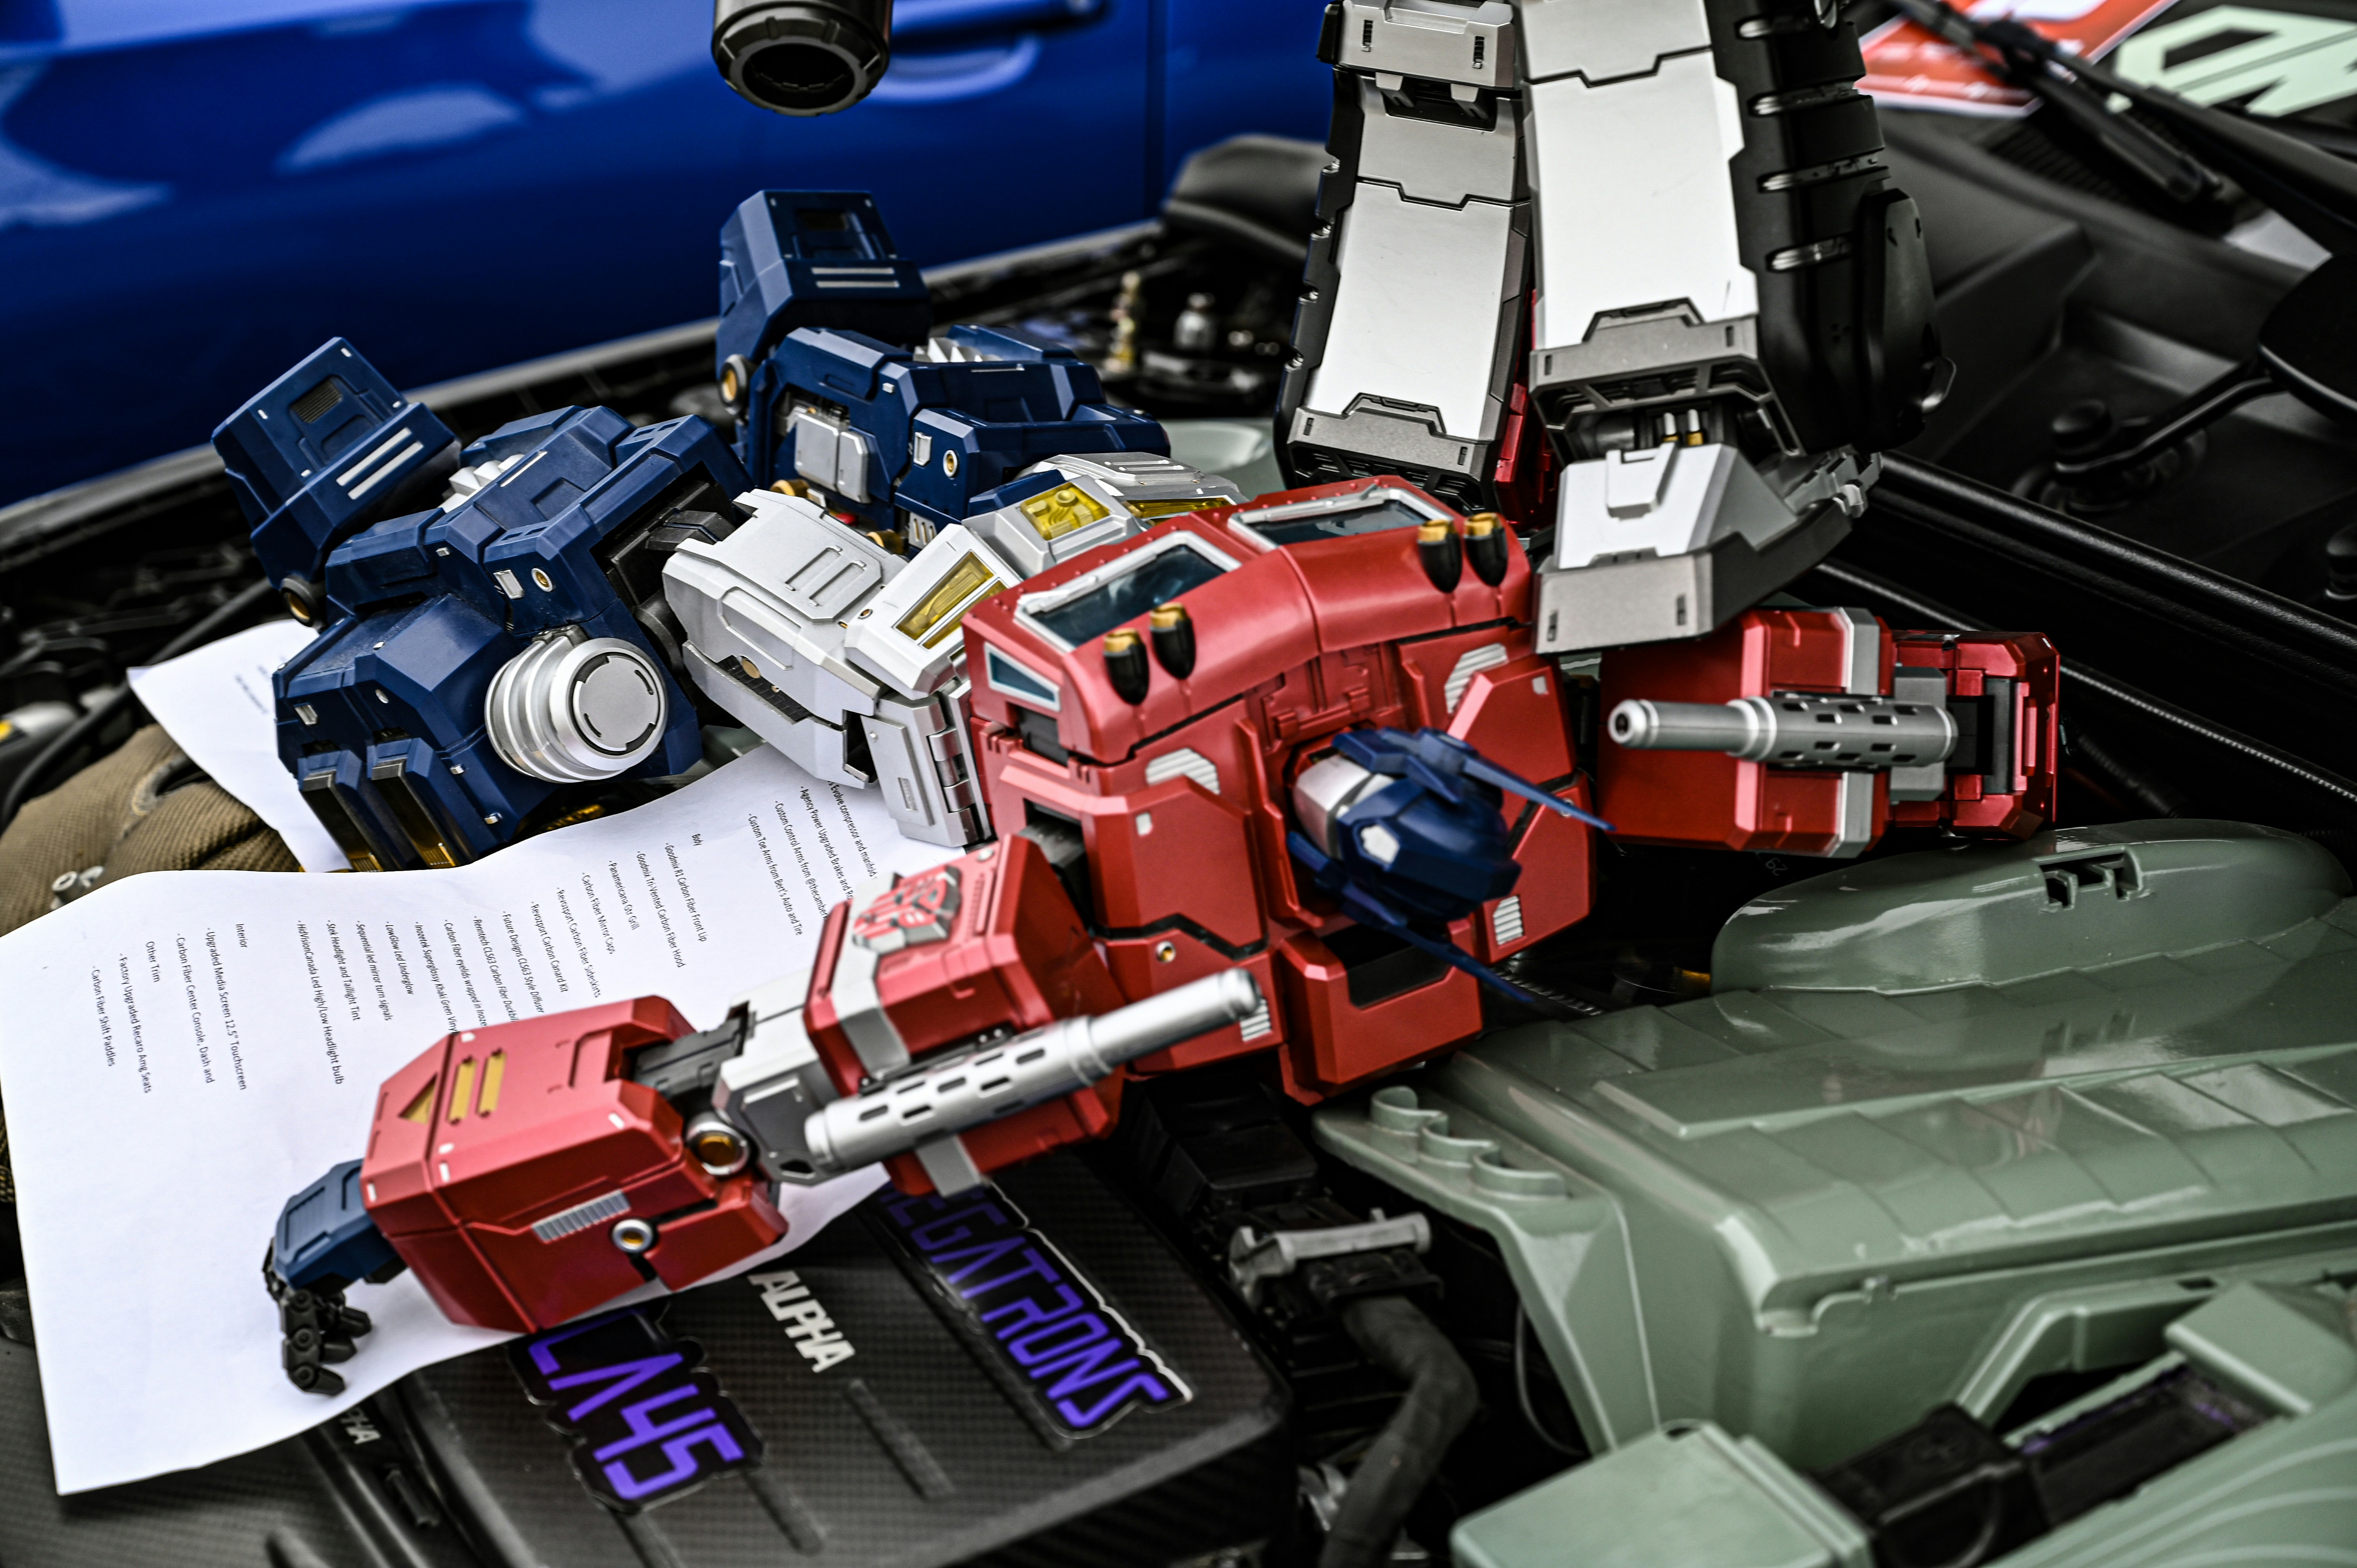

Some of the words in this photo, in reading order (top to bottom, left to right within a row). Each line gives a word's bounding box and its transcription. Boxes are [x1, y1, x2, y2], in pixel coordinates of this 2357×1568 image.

[830, 784, 845, 806] Evolve
[775, 803, 789, 825] Custom
[839, 805, 860, 839] compressor
[748, 816, 762, 838] Custom
[784, 825, 800, 847] Control
[691, 833, 704, 846] Body
[757, 837, 767, 849] Toe
[800, 789, 815, 811] Agency
[809, 809, 823, 829] Power
[818, 828, 838, 858] Upgraded
[830, 858, 845, 879] Brakes
[839, 879, 852, 891] and
[855, 839, 868, 852] and
[664, 845, 680, 869] Goodmix
[761, 849, 774, 865] Arms
[793, 847, 805, 863] Arms
[860, 851, 878, 877] manifold
[674, 869, 684, 878] R1
[768, 864, 779, 879] from
[800, 862, 811, 878] from
[608, 863, 628, 905] Panamericana
[677, 878, 691, 898] Carbon
[774, 879, 788, 897] Bert's
[624, 904, 633, 915] Gtr
[685, 898, 697, 913] Fiber
[781, 897, 793, 912] Auto
[805, 878, 829, 920] @thecamberk
[530, 904, 548, 937] Revozport
[581, 875, 595, 899] Carbon
[590, 898, 602, 915] Fiber
[597, 915, 610, 937] Mirror
[605, 937, 615, 954] Caps
[636, 853, 652, 878] Goodmix
[645, 877, 665, 909] Tri-Vented
[657, 909, 671, 932] Carbon
[666, 932, 677, 948] Fiber
[672, 949, 686, 968] Hood
[788, 913, 800, 924] and
[326, 923, 339, 936] Stek
[443, 923, 457, 943] Carbon
[473, 919, 491, 946] Renntech
[502, 914, 515, 934] Future
[628, 916, 640, 930] Grill
[691, 914, 704, 932] Front
[793, 923, 803, 936] Tire
[235, 923, 248, 948] Interior
[356, 924, 375, 953] Sequential
[385, 925, 400, 950] LowGlow
[414, 925, 431, 948] Inozetek
[509, 934, 523, 957] Designs
[557, 890, 574, 924] Revozport
[569, 923, 582, 948] Carbon
[578, 947, 589, 964] Fiber
[584, 965, 601, 998] Sideskirts
[698, 932, 707, 942] Lip
[145, 941, 157, 962] Other
[176, 938, 188, 964] Carbon
[205, 932, 223, 966] Upgraded
[297, 924, 319, 975] HidVisionCanada
[330, 937, 346, 964] Headlight
[366, 954, 378, 963] led
[394, 951, 406, 961] Led
[451, 944, 462, 958] Fiber
[482, 947, 497, 964] CLS63
[542, 936, 556, 960] Carbon
[119, 957, 130, 985] Factory
[150, 964, 161, 982] Trim
[182, 965, 193, 983] Fiber
[339, 966, 351, 978] and
[369, 965, 381, 983] mirror
[422, 949, 440, 982] Superglossy
[456, 959, 471, 979] eyelids
[489, 965, 503, 985] Carbon
[518, 958, 532, 975] CLS63
[550, 960, 567, 983] Canard
[92, 969, 102, 996] Carbon
[214, 967, 226, 991] Media
[311, 976, 323, 988] Led
[398, 962, 414, 995] Underglow
[524, 976, 537, 990] Style
[558, 983, 569, 992] Kit
[186, 985, 198, 1010] Center
[343, 979, 357, 1005] Taillight
[375, 985, 385, 998] turn
[435, 984, 448, 999] Khaki
[464, 980, 481, 1003] wrapped
[497, 986, 509, 999] Fiber
[530, 991, 544, 1013] Diffuser
[95, 996, 106, 1015] Fiber
[123, 985, 140, 1024] Upgraded
[219, 992, 231, 1018] Screen
[314, 990, 329, 1024] High/Low
[350, 1006, 361, 1021] Tint
[378, 999, 394, 1021] signals
[440, 1000, 452, 1015] Green
[99, 1016, 111, 1035] Shift
[225, 1019, 239, 1038] 12.5"
[476, 1010, 487, 1026] Inoze
[132, 1025, 143, 1052] Recaro
[192, 1012, 206, 1046] Console,
[103, 1035, 116, 1067] Paddles
[323, 1026, 339, 1064] Headlight
[138, 1055, 147, 1072] Amg
[199, 1046, 211, 1067] Dash
[230, 1041, 247, 1090] Touchscreen
[141, 1072, 152, 1093] Seats
[204, 1069, 216, 1083] and
[332, 1065, 345, 1084] bulb
[879, 1183, 1169, 1428] EGATRONS
[747, 1270, 855, 1373] ALPHA
[528, 1307, 745, 1500] LA45
[340, 1407, 381, 1444] PHA
